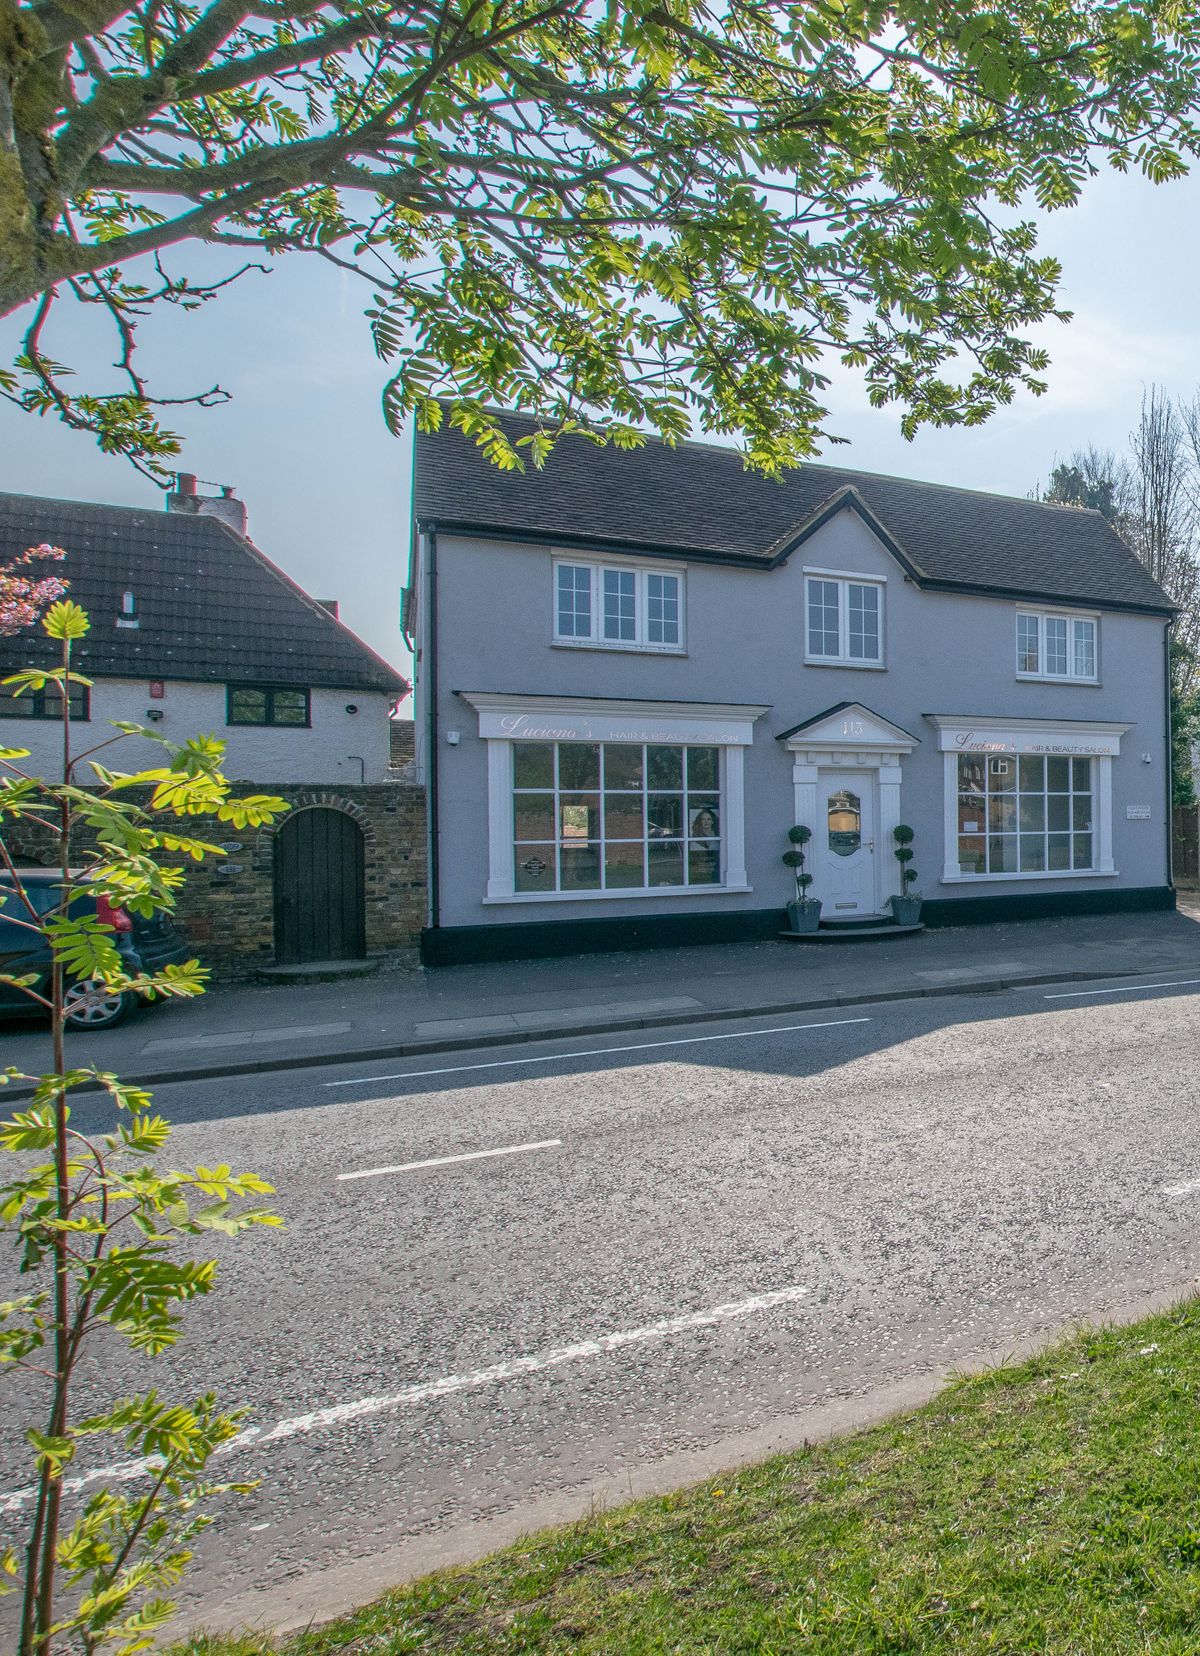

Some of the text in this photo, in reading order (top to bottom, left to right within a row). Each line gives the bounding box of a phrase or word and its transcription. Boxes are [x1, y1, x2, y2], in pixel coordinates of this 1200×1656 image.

[500, 714, 592, 738] Luciana's
[610, 731, 638, 739] HAIR
[1052, 745, 1083, 753] BEAUTY
